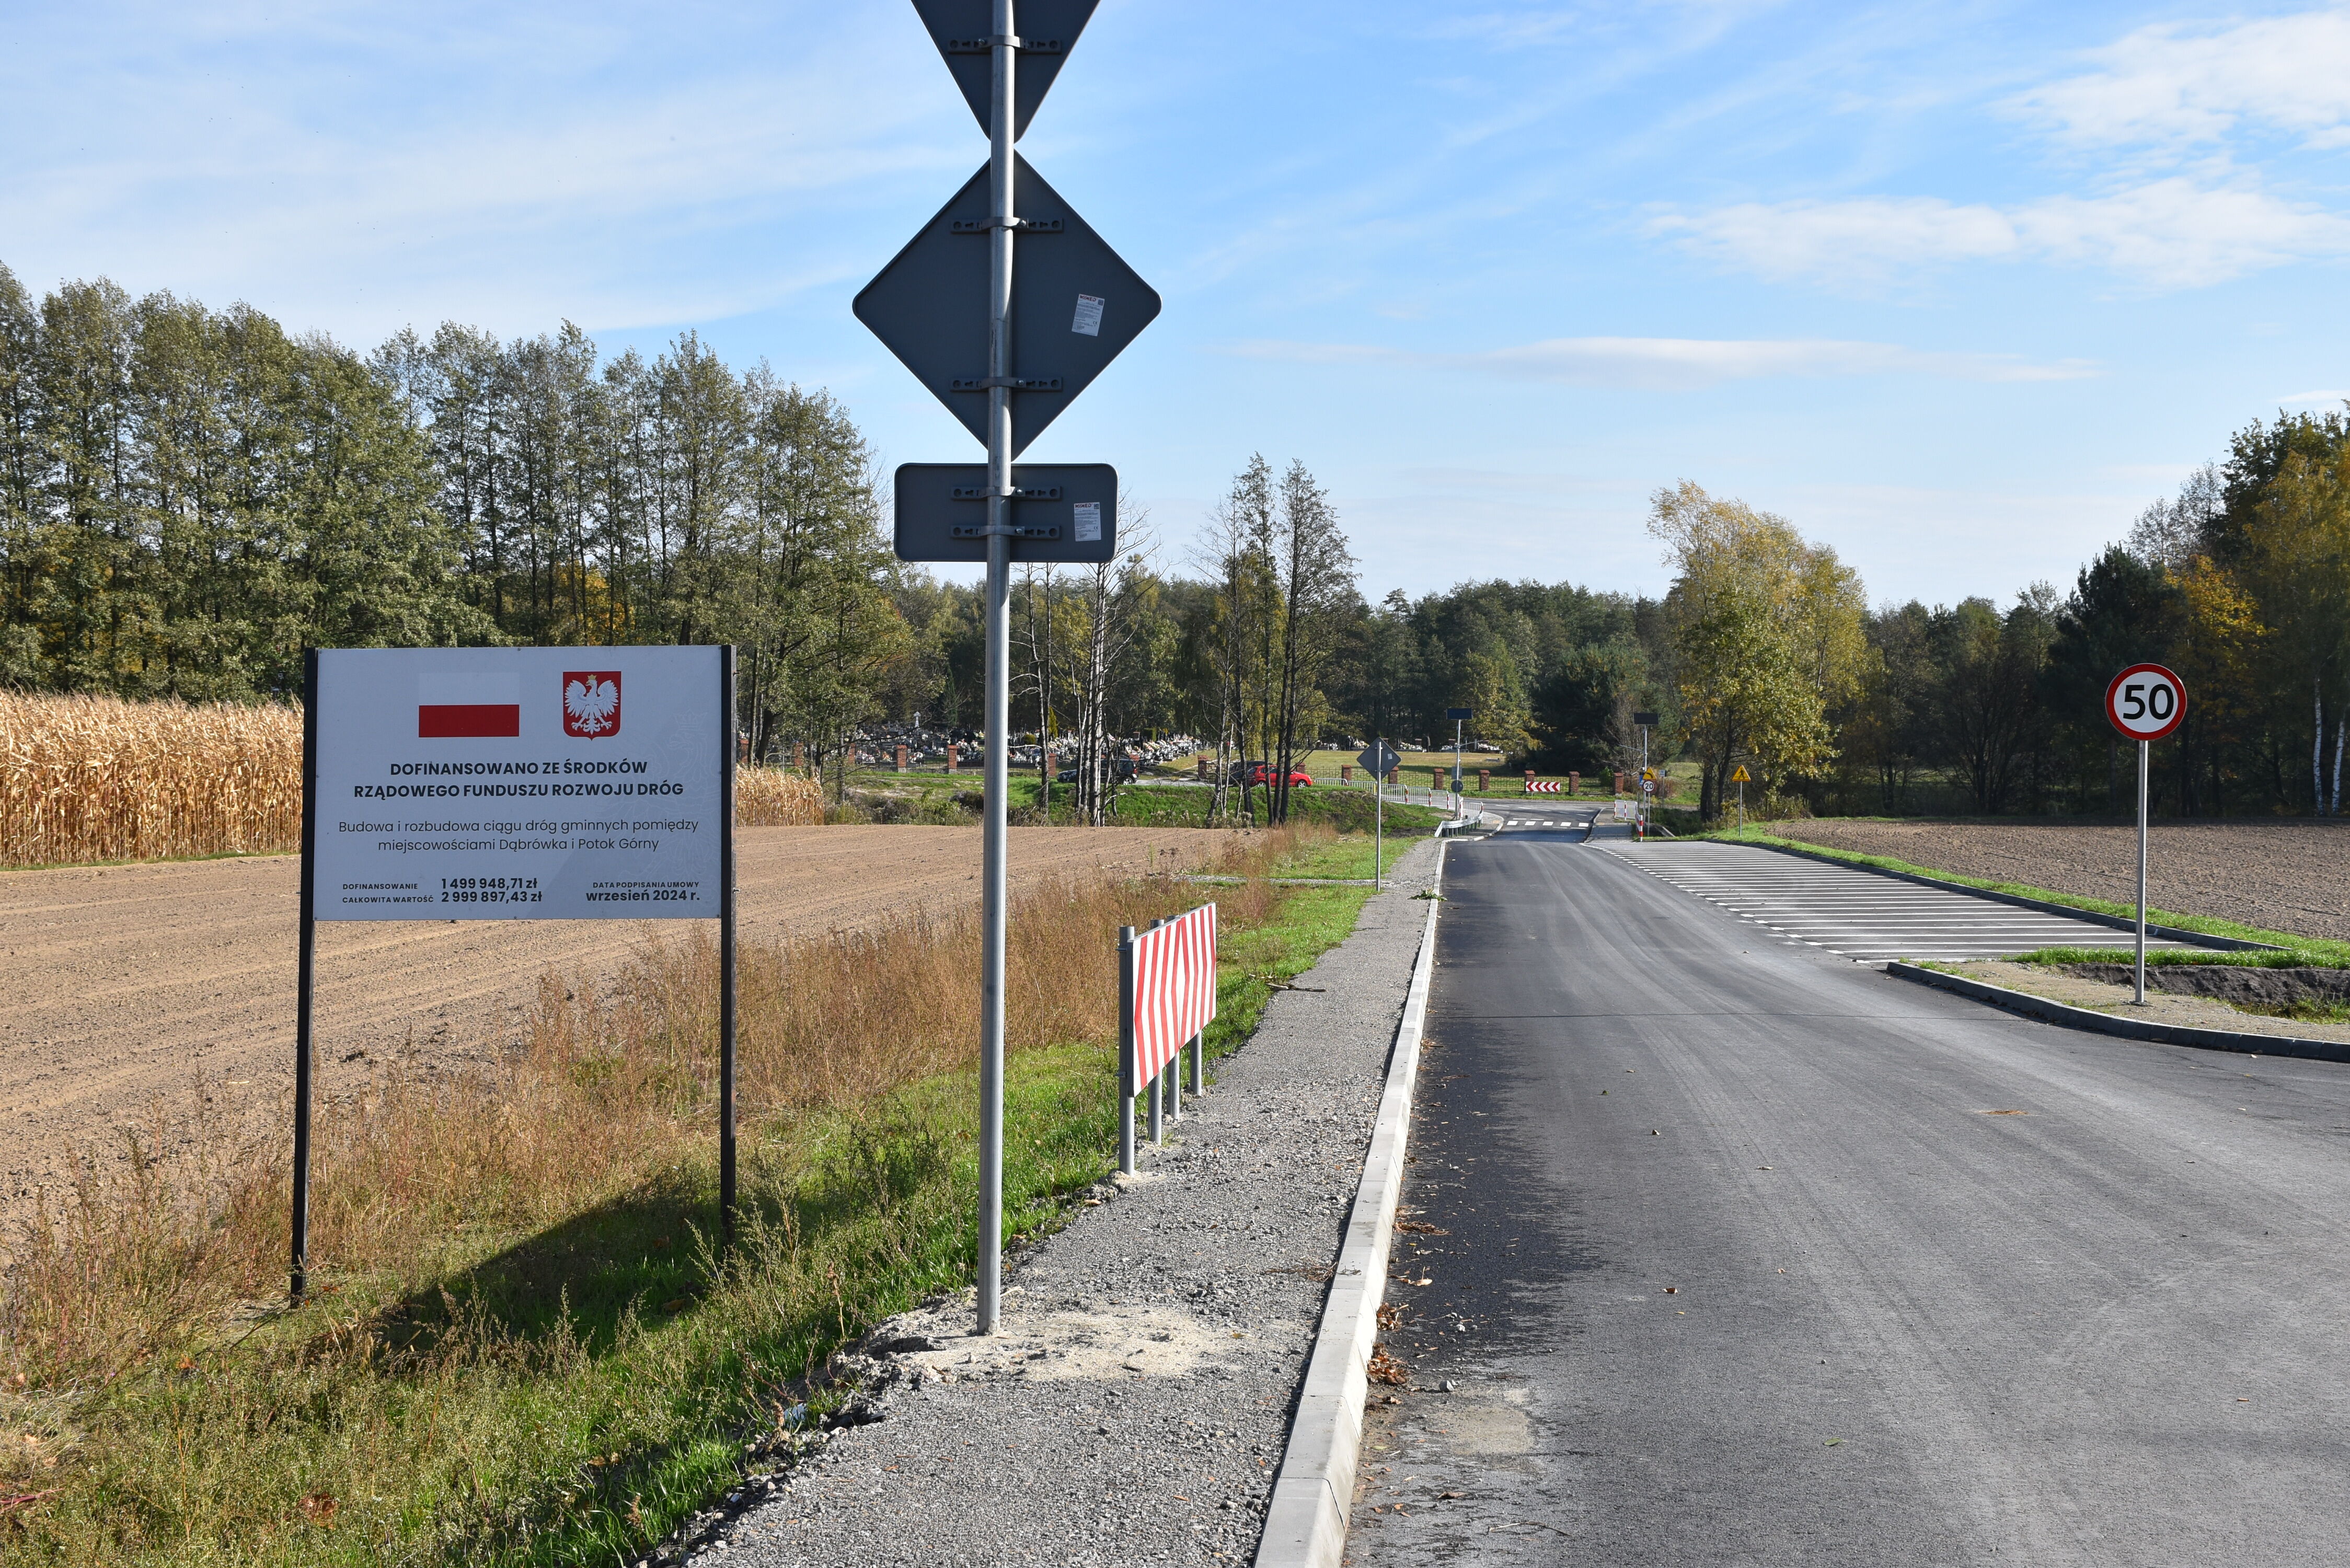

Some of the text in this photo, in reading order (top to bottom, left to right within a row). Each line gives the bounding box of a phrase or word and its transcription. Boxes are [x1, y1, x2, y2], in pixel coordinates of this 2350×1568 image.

[2123, 684, 2174, 720] 50
[390, 758, 648, 775] DOFINANSOWANO ZE ŚRODKÓW
[354, 779, 684, 800] RZĄDOWEGO FUNDUSZU ROZWOJU DRÓG
[339, 818, 699, 835] Budowa i rozbudowa ciągu dróg gminnych pomiędzy
[378, 837, 660, 854] miejscowościami Dąbrówka i Potok Górny
[450, 878, 478, 889] 499
[479, 878, 523, 891] 948,71
[525, 878, 538, 889] zł
[393, 895, 434, 903] WARTOŚĆ
[441, 892, 450, 903] 2
[453, 891, 478, 902] 999
[480, 891, 528, 904] 897,43
[530, 891, 543, 902] zł
[585, 889, 700, 901] wrzesień 2024 r.
